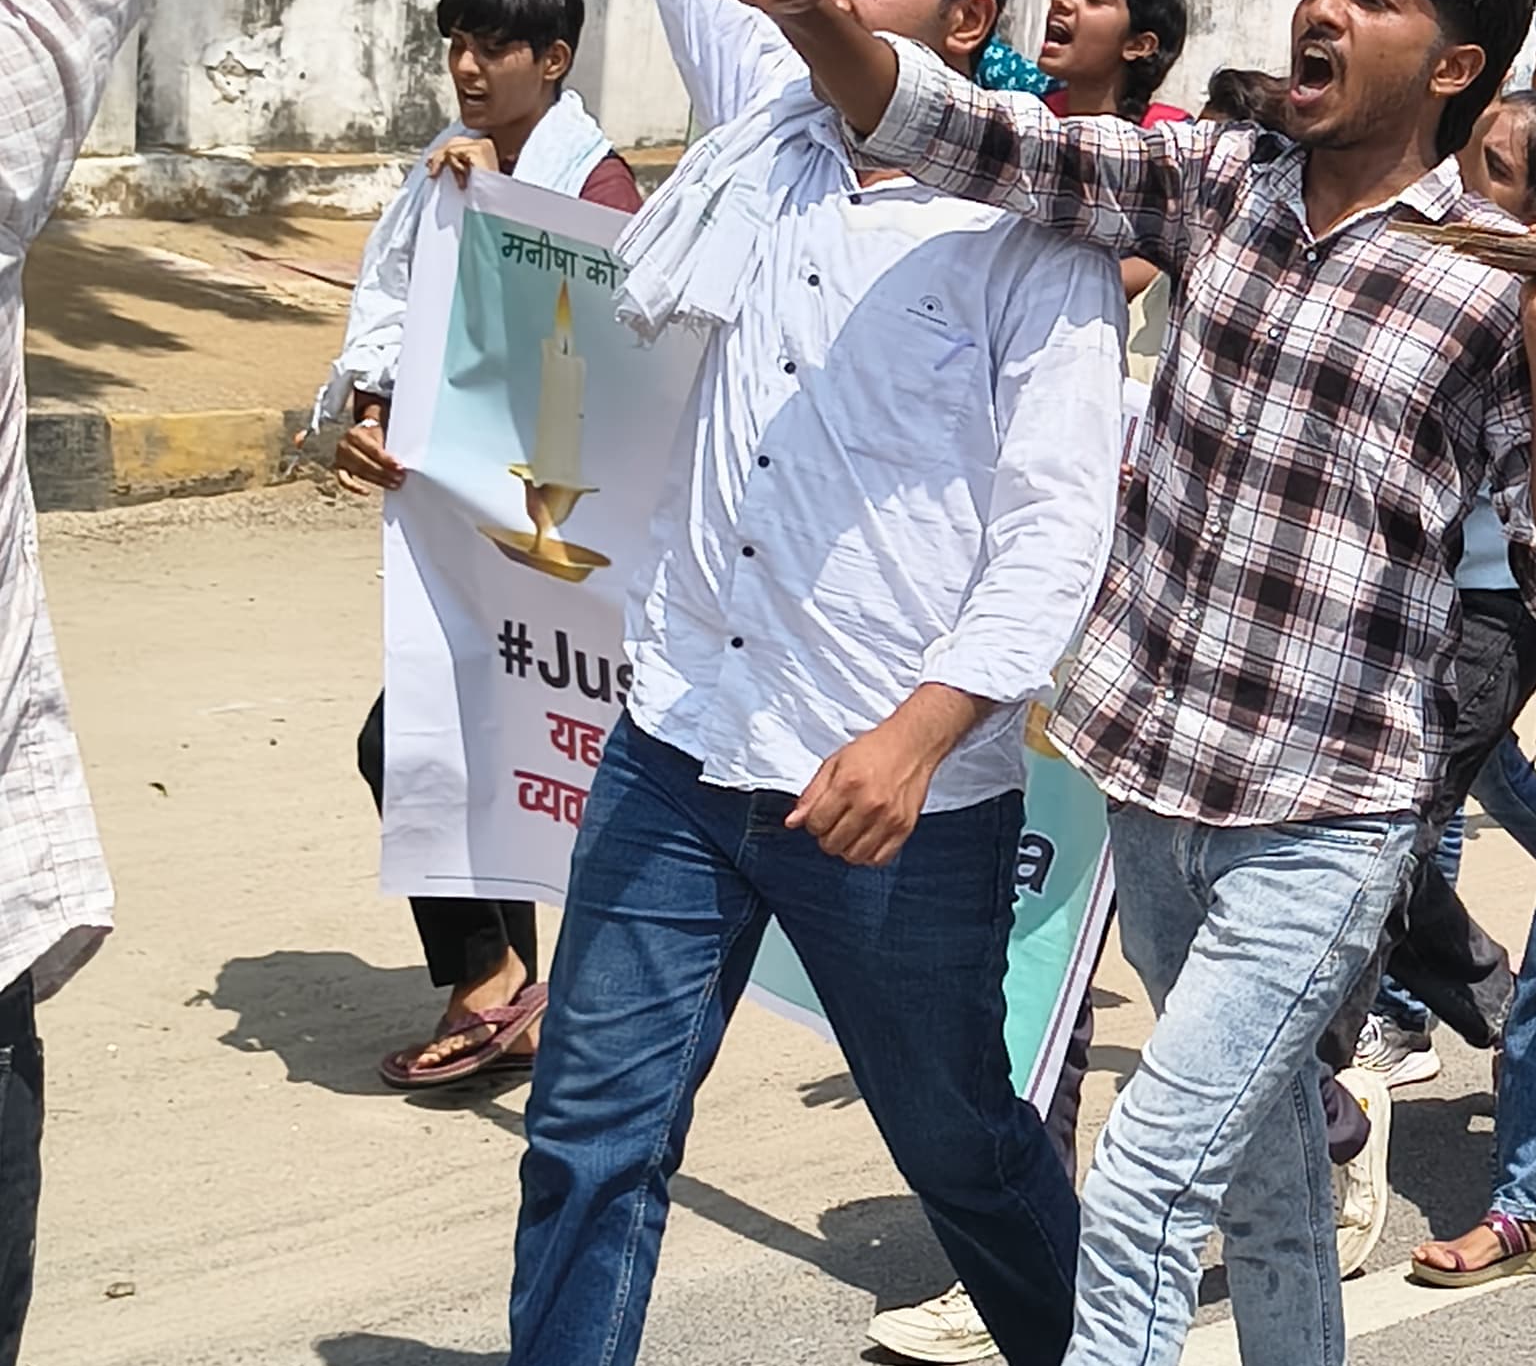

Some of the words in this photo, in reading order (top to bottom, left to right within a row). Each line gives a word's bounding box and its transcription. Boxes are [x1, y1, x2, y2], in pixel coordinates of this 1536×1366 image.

[501, 230, 579, 279] मनीषा
[582, 248, 620, 291] को
[546, 711, 605, 768] यह
